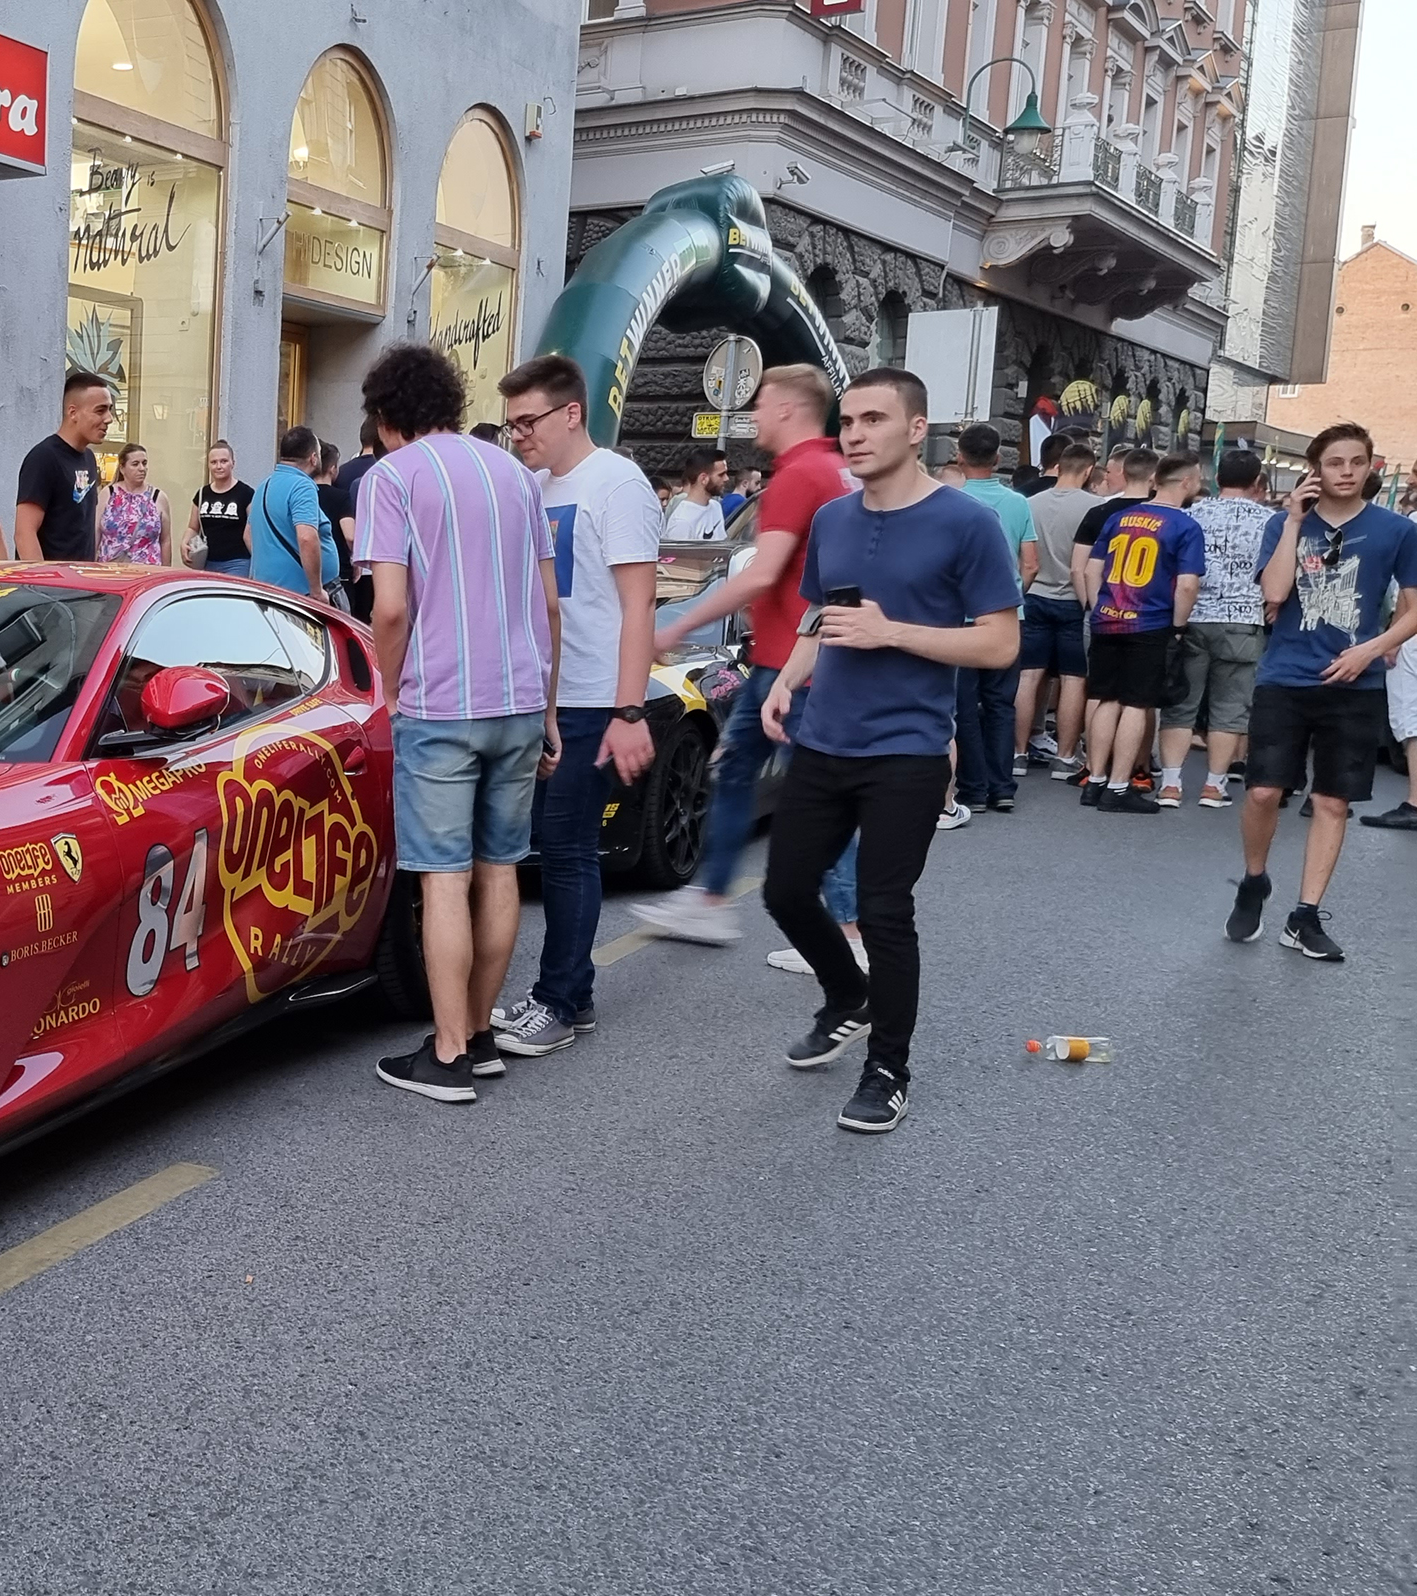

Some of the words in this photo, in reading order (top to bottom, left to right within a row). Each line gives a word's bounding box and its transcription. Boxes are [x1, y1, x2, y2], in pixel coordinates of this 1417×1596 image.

[73, 180, 192, 274] natural
[608, 252, 681, 422] BETWINNER
[1107, 533, 1159, 588] 10
[254, 739, 343, 803] ONELIFERALLY.COM
[7, 874, 58, 895] MEMBERS
[125, 827, 210, 997] 84
[10, 942, 39, 962] BORIS
[41, 930, 79, 953] BECKER
[250, 925, 317, 968] RALLY
[33, 997, 101, 1036] ONARDO
